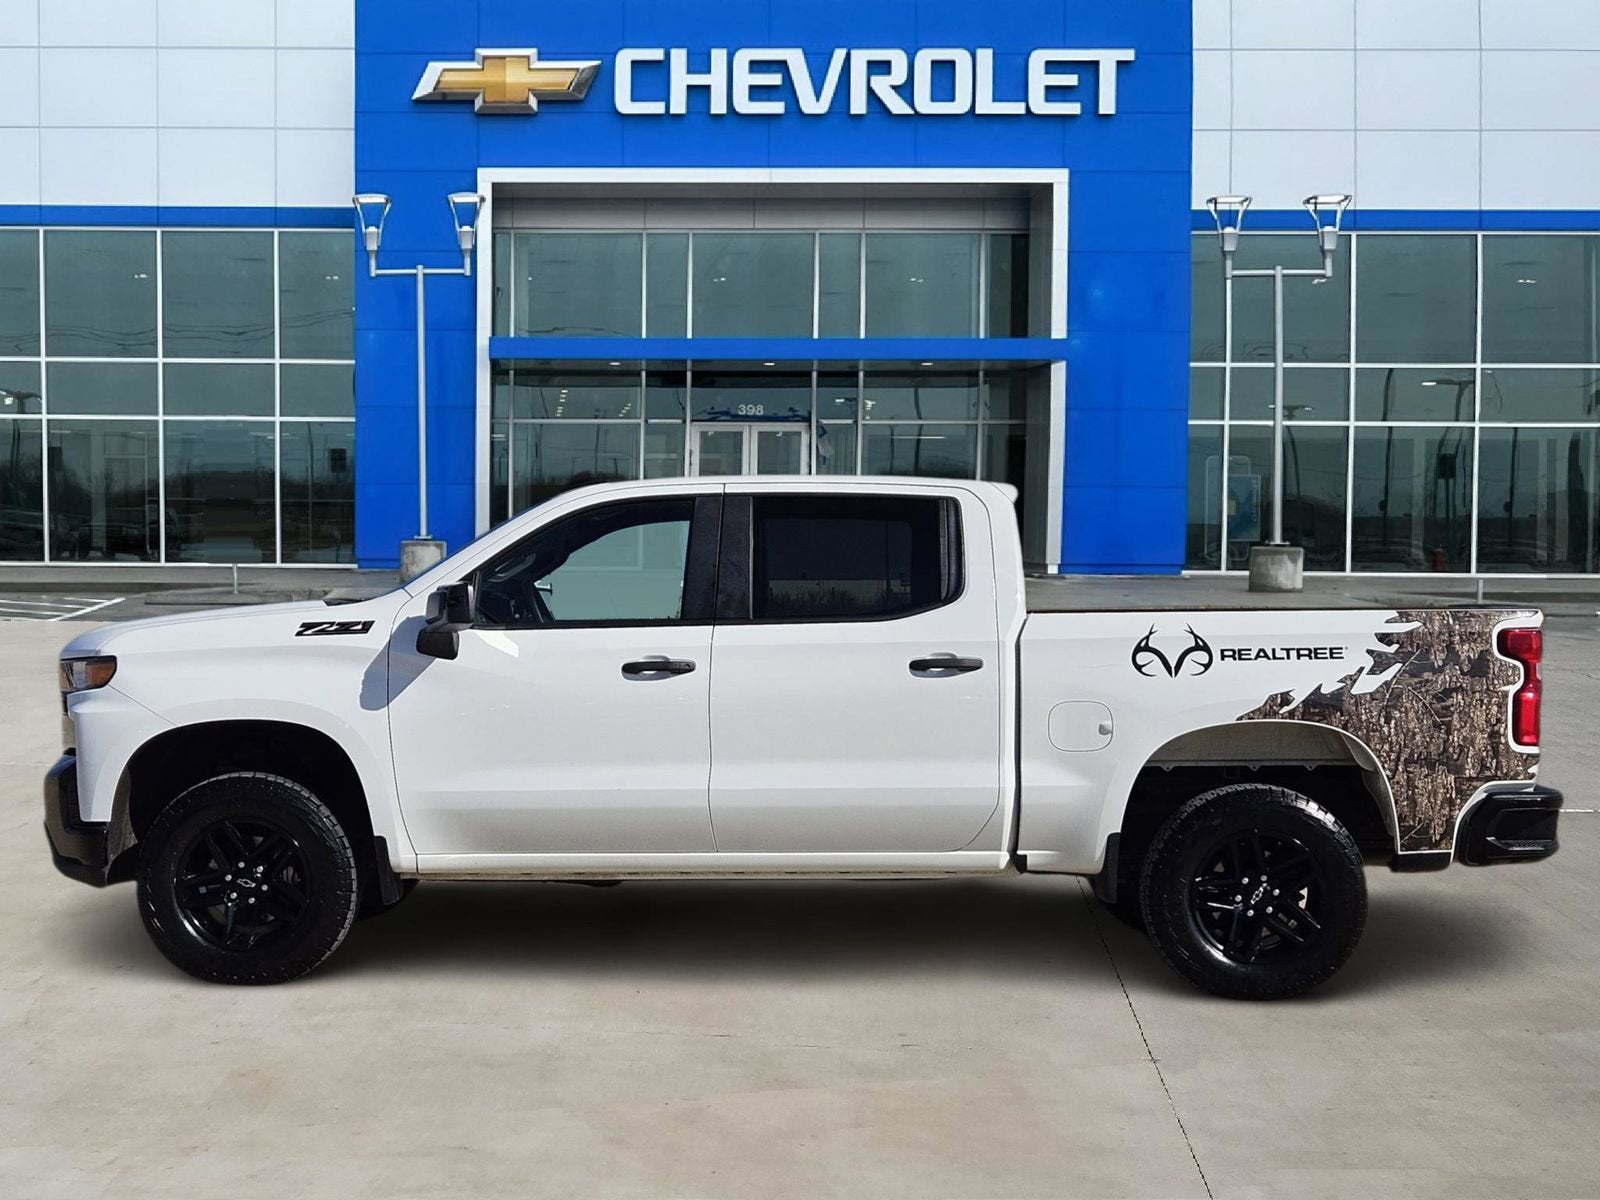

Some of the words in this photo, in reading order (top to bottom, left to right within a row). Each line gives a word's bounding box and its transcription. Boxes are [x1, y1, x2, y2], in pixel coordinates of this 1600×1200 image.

[614, 48, 1135, 115] CHEVROLET
[738, 404, 764, 416] 398
[1220, 647, 1344, 661] REALTREE
